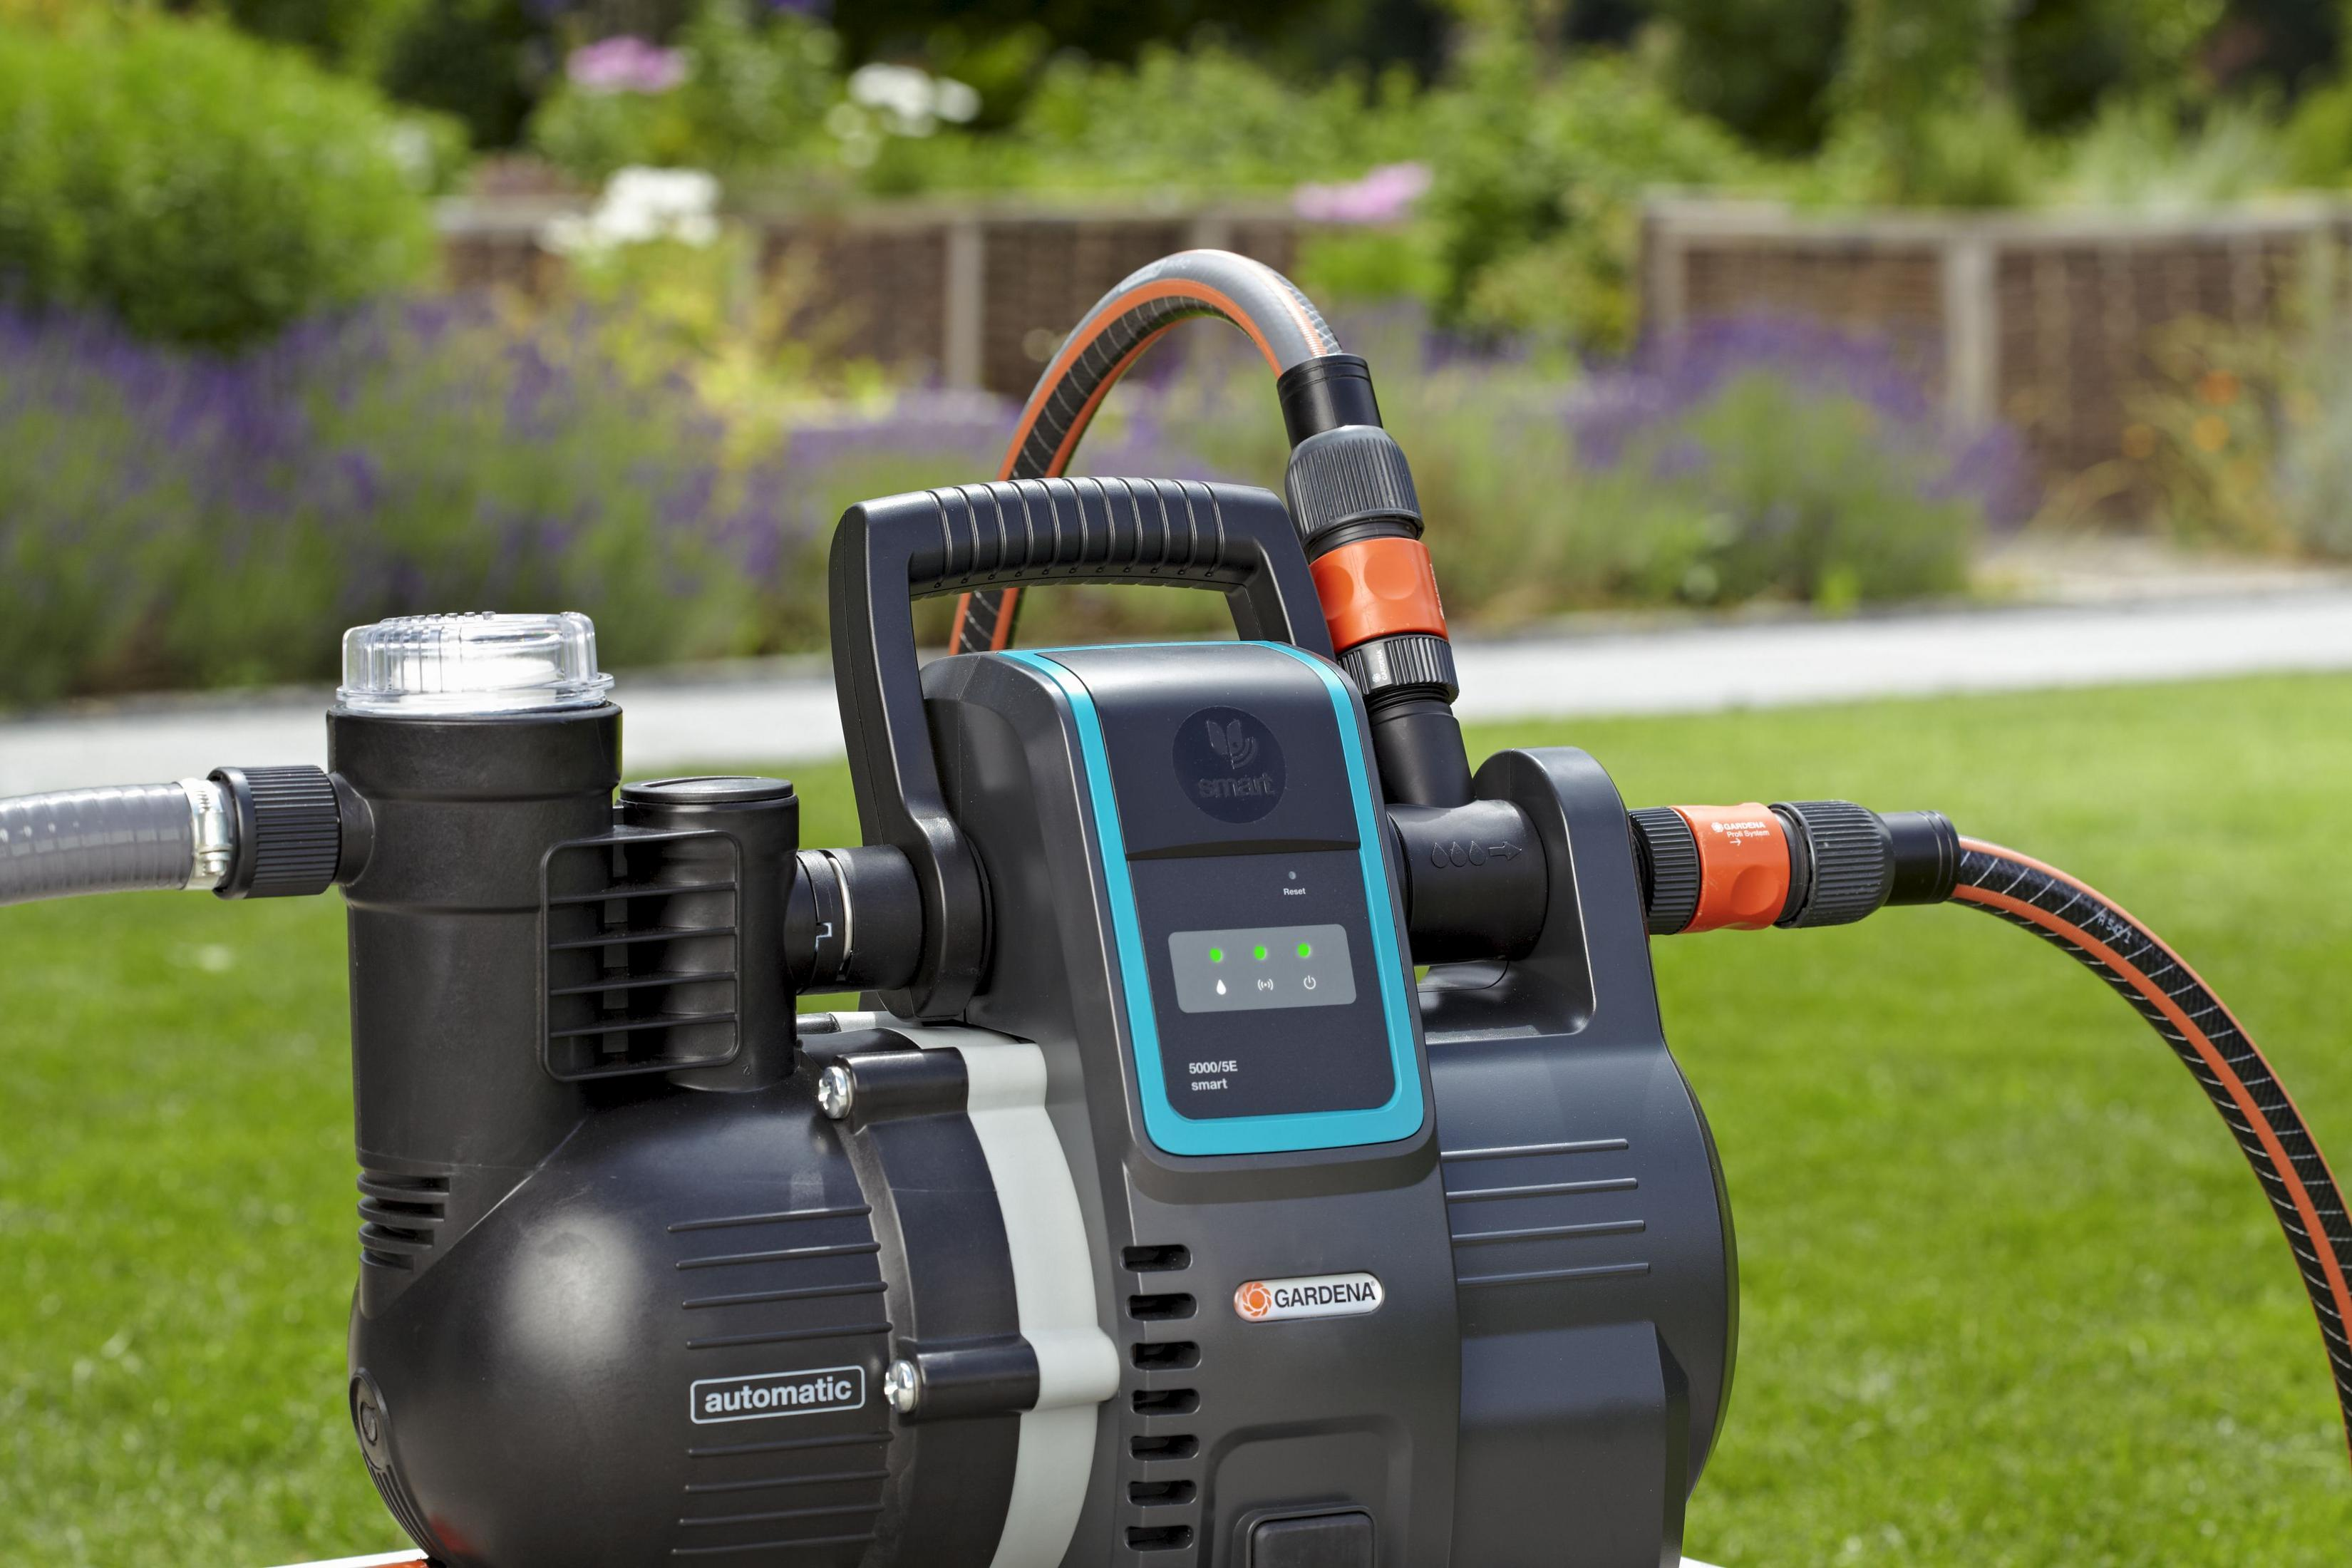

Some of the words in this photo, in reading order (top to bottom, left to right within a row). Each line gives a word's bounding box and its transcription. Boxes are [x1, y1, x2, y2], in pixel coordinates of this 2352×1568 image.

[1198, 773, 1275, 798] smart
[1723, 821, 1765, 830] GARDENA
[1283, 887, 1306, 896] Reset
[1189, 1061, 1238, 1074] 5000/5E
[1191, 1078, 1227, 1091] smart
[1274, 1281, 1376, 1308] GARDENA
[705, 1376, 852, 1413] automatic
